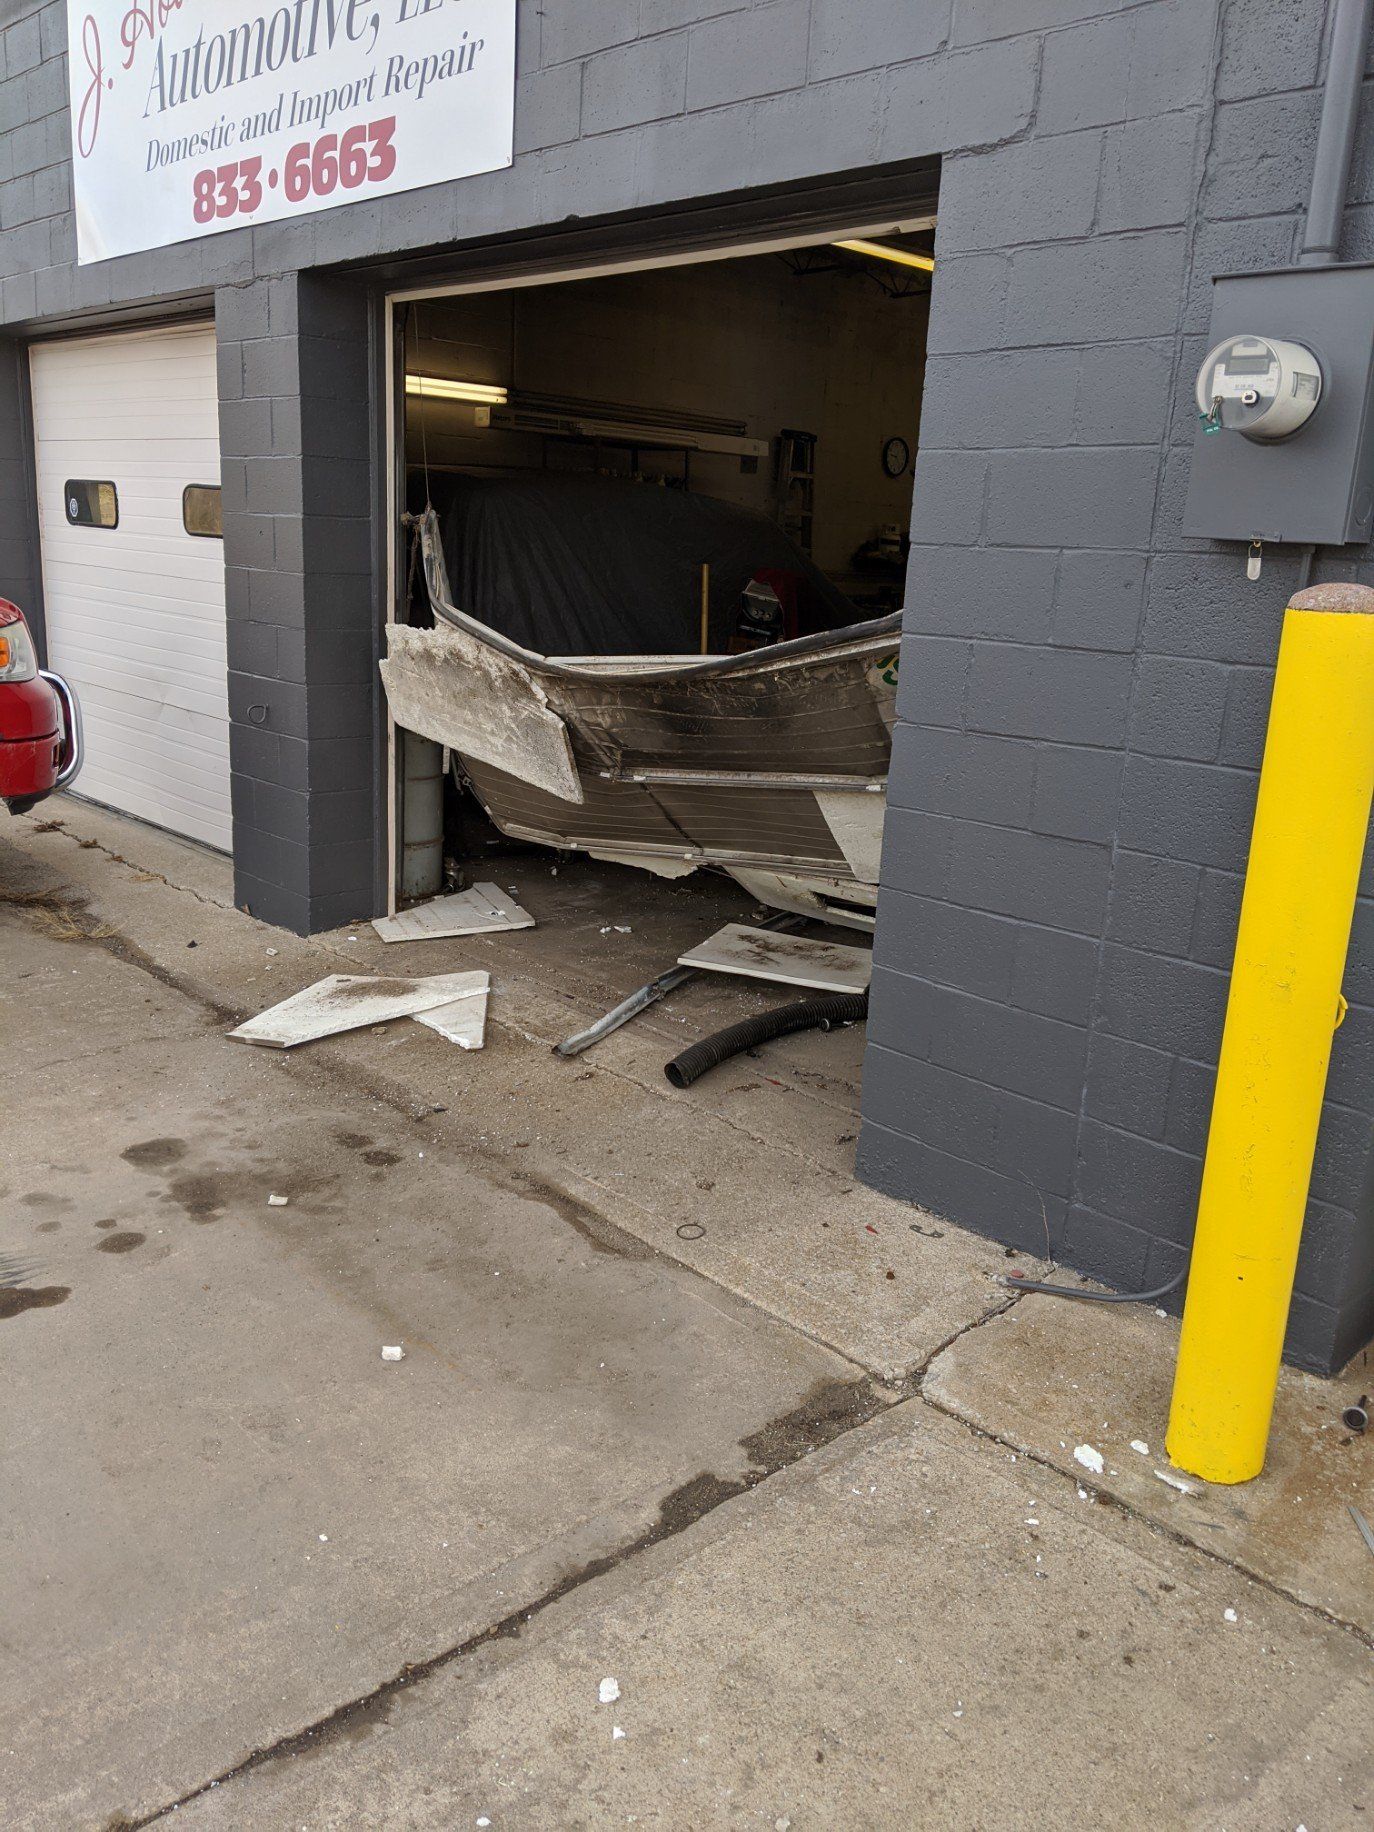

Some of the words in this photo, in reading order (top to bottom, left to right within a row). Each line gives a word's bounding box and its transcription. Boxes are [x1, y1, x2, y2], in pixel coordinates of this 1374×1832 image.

[142, 0, 380, 118] Automotive,
[145, 114, 235, 172] Domestic
[239, 93, 284, 143] and
[287, 66, 377, 130] Import
[381, 31, 485, 100] Repair
